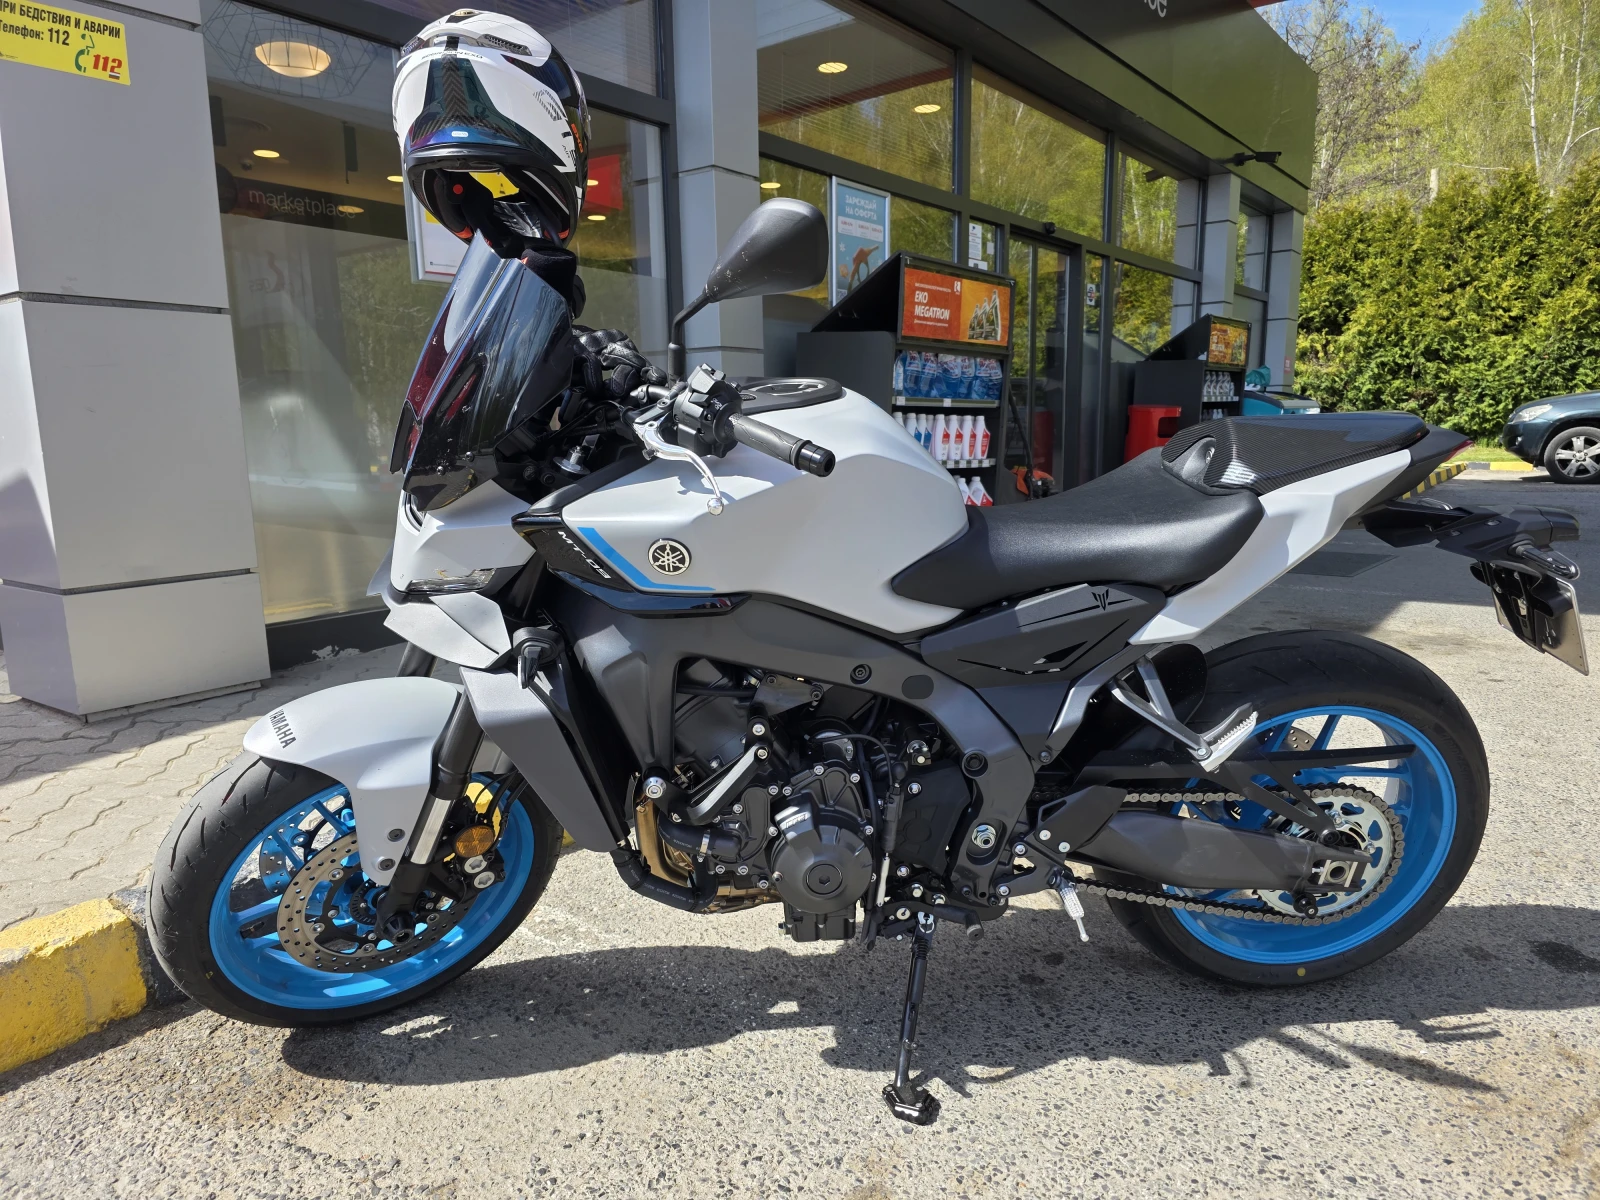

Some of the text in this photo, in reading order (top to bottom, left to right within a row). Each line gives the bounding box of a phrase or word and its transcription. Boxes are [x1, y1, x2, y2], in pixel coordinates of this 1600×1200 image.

[20, 4, 71, 27] БЕДСТВИЯ
[74, 17, 81, 29] И
[84, 20, 121, 39] АВАРИИ
[48, 27, 70, 46] 112
[92, 54, 122, 75] 112
[248, 189, 356, 219] marketplace
[914, 304, 950, 320] MEGATRON
[558, 531, 611, 578] MT-09
[269, 708, 297, 749] YAMAHA
